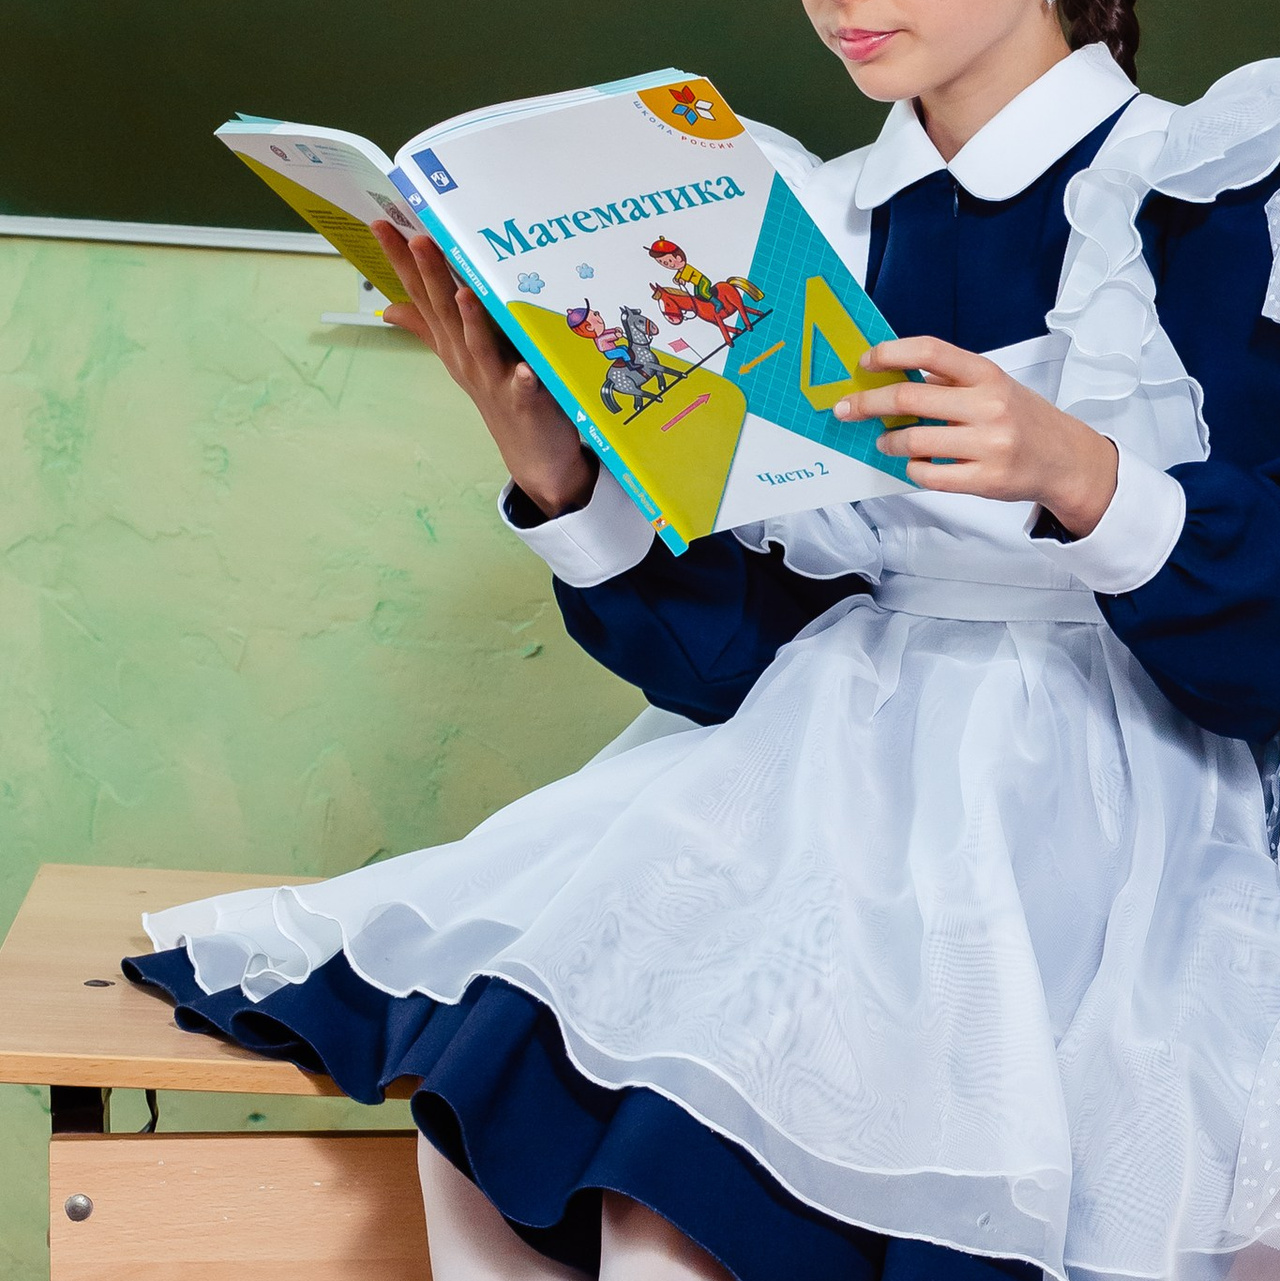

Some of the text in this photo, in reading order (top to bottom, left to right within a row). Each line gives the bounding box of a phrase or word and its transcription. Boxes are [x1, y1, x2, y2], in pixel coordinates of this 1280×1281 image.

[633, 100, 735, 150] ШКОЛА РОССИИ
[477, 175, 746, 263] Математика
[757, 461, 830, 487] Часть 2
